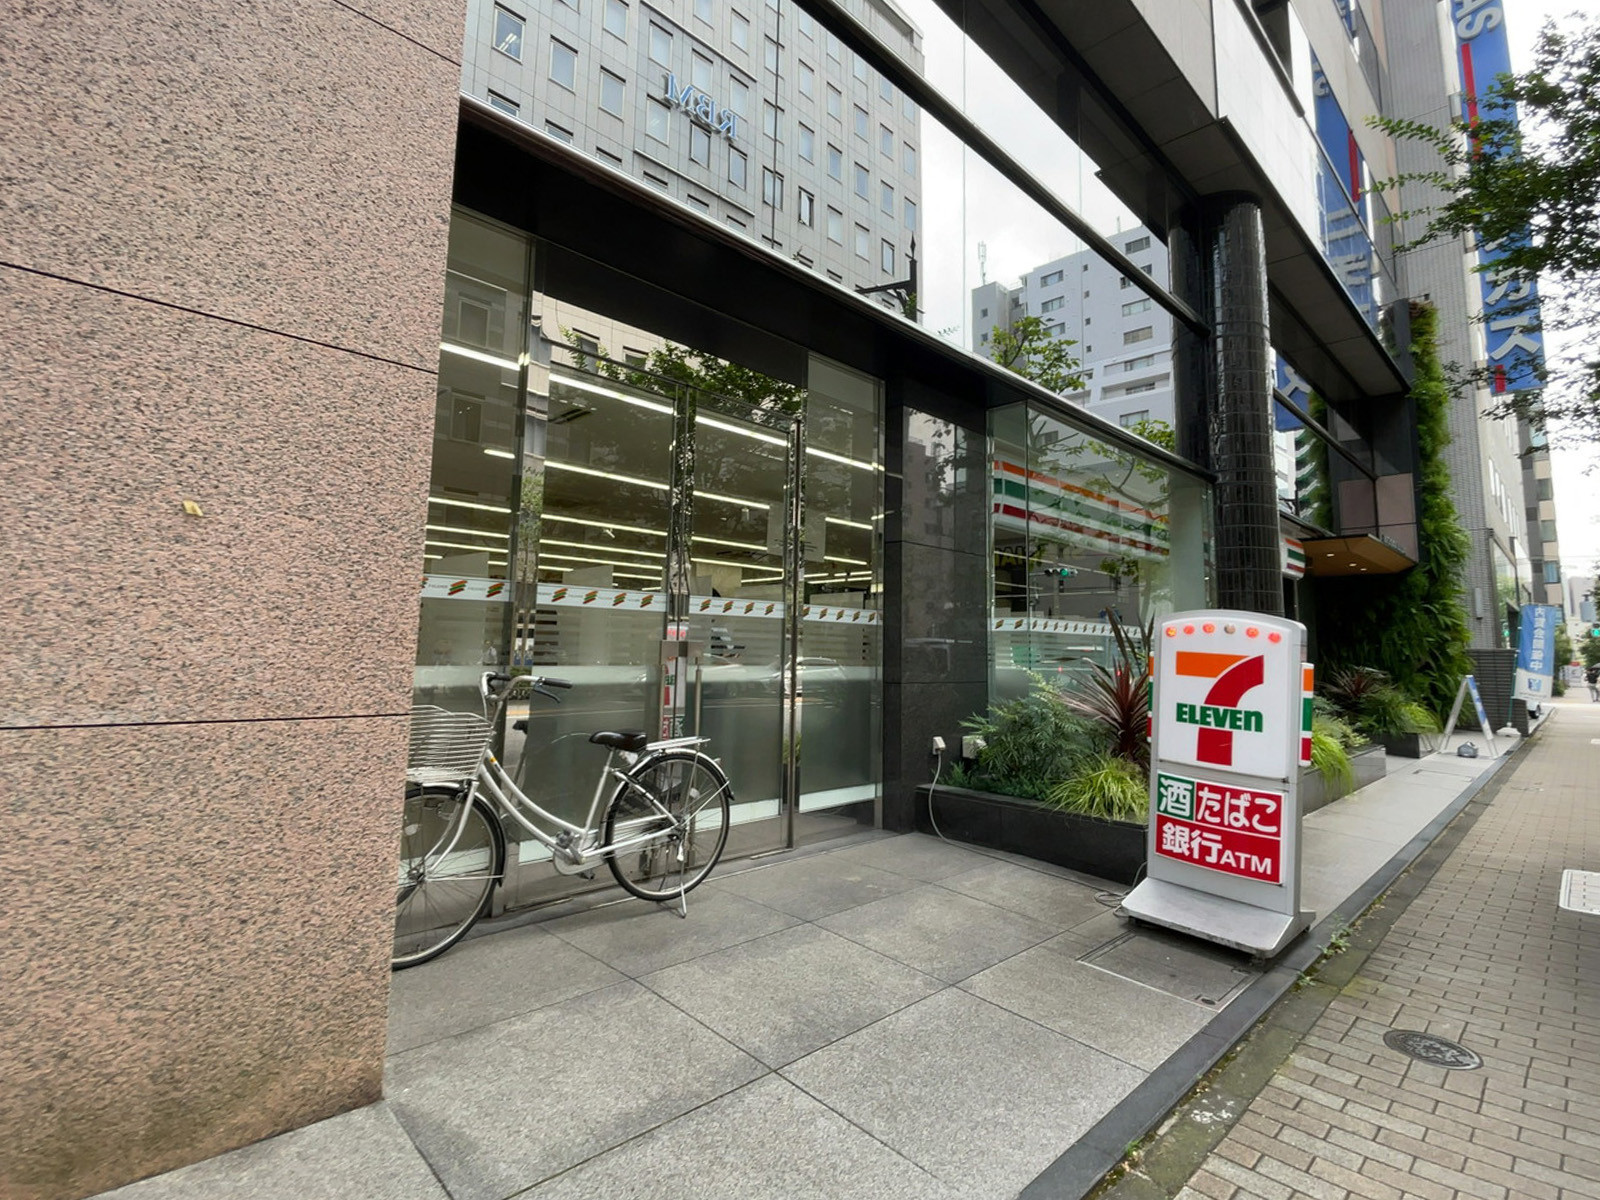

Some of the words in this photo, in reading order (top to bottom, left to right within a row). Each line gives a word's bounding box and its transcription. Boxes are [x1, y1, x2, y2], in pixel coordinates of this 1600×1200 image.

[1159, 776, 1194, 817] 酒
[1197, 786, 1278, 833] たばこ
